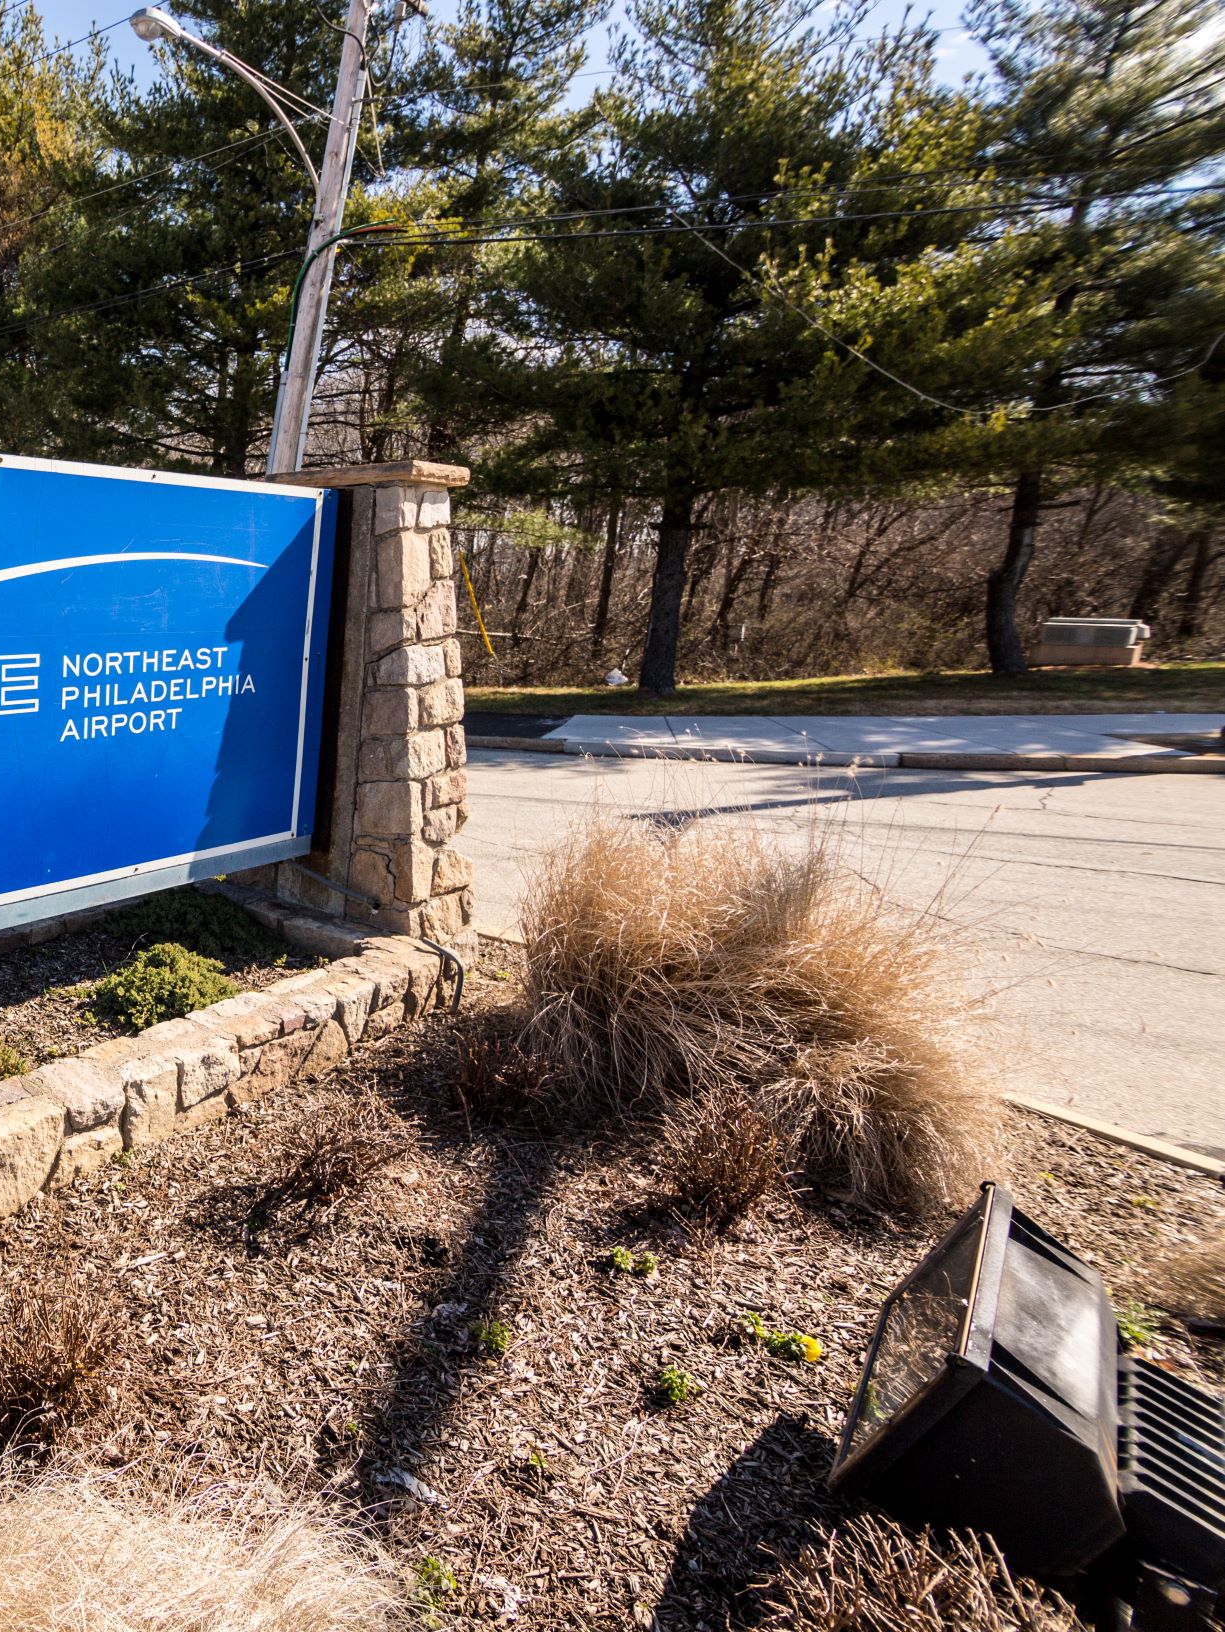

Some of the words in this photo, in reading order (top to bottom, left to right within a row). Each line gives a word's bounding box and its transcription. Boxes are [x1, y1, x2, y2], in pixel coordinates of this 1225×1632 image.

[62, 646, 229, 678] NORTHEAST
[61, 674, 256, 710] PHILADELPHIA
[59, 707, 183, 743] AIRPORT
